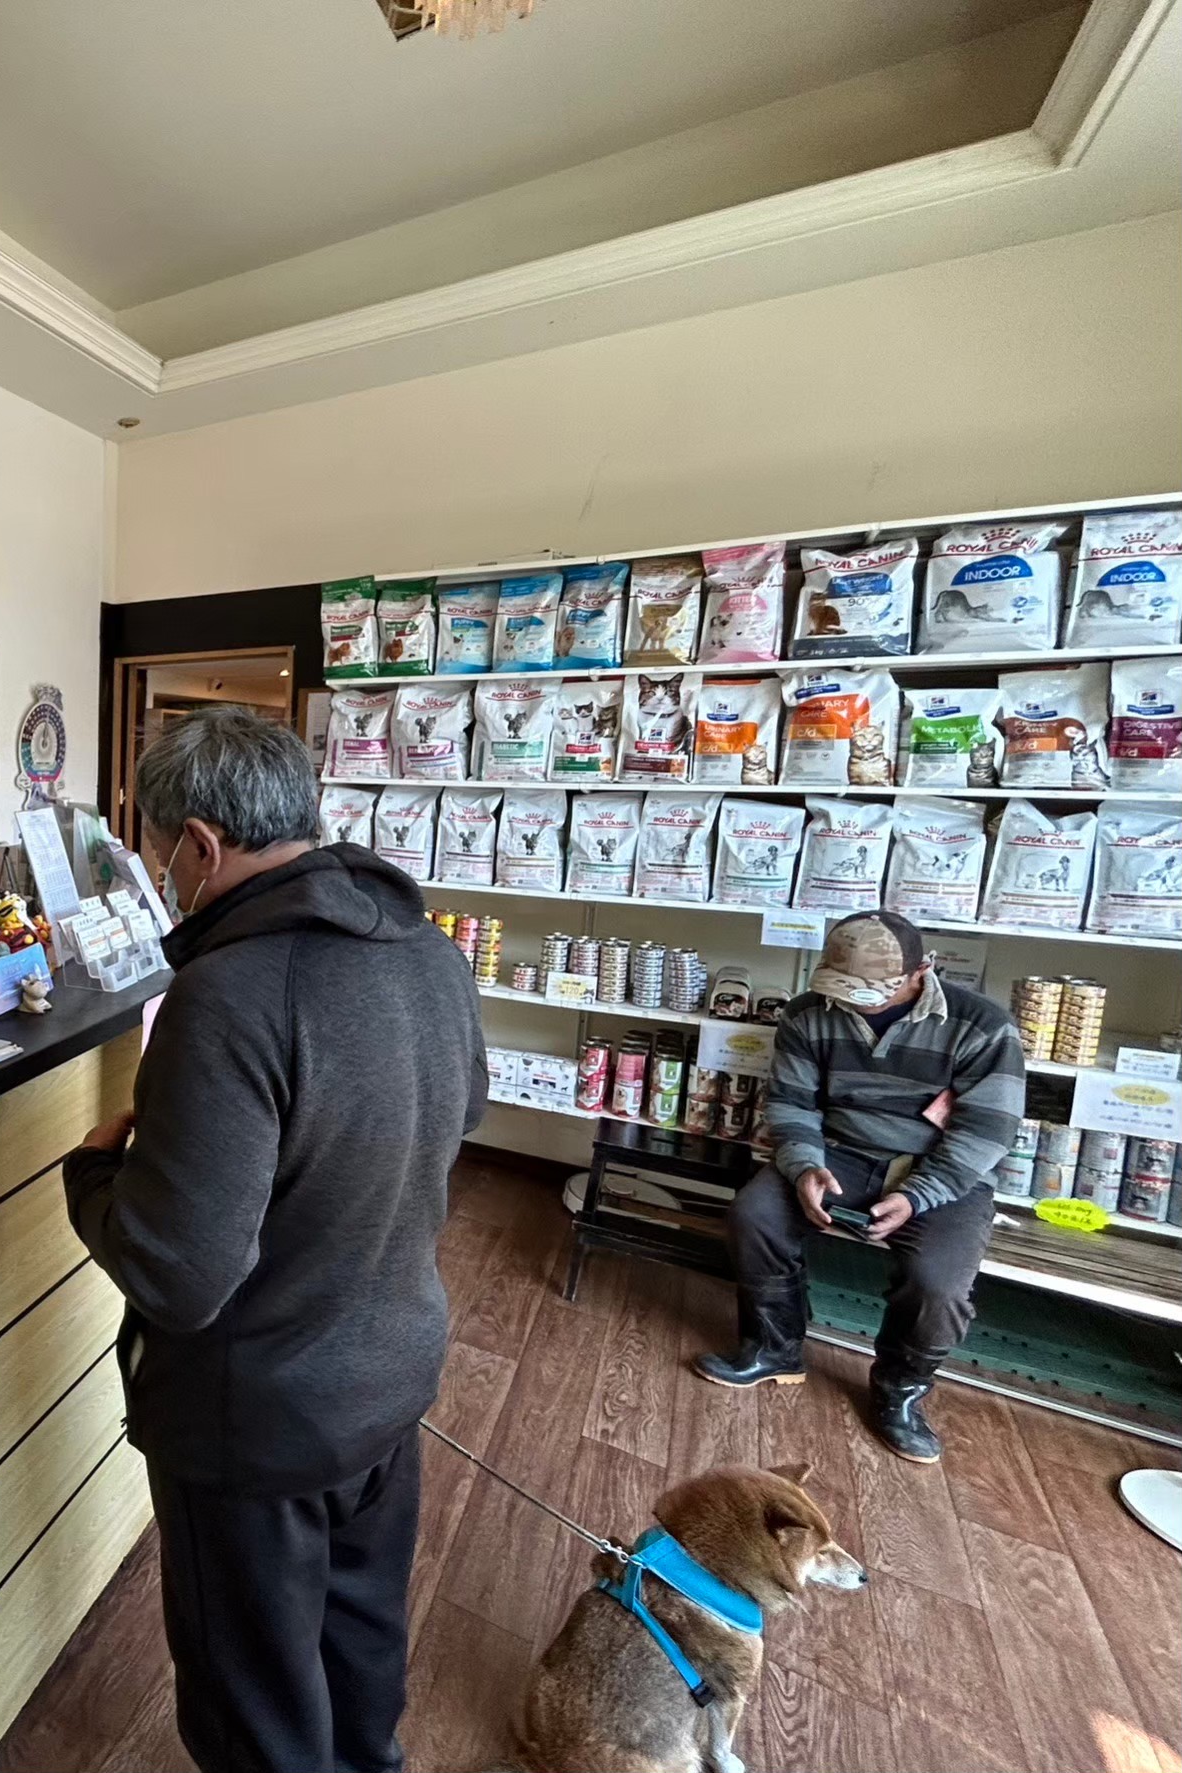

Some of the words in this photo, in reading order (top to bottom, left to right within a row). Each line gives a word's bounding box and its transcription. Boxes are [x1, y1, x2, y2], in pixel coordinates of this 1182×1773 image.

[946, 543, 993, 552] ROYAL
[1090, 546, 1135, 556] ROYAL
[858, 551, 905, 567] CANIN
[964, 565, 1021, 581] INDOOR
[1110, 572, 1157, 583] INDOOR
[637, 589, 662, 599] ROYAL
[517, 690, 541, 699] CANIN
[704, 724, 743, 734] URINARY
[653, 816, 676, 824] ROYAL
[820, 828, 846, 836] ROYAL
[1015, 835, 1046, 845] ROYAL
